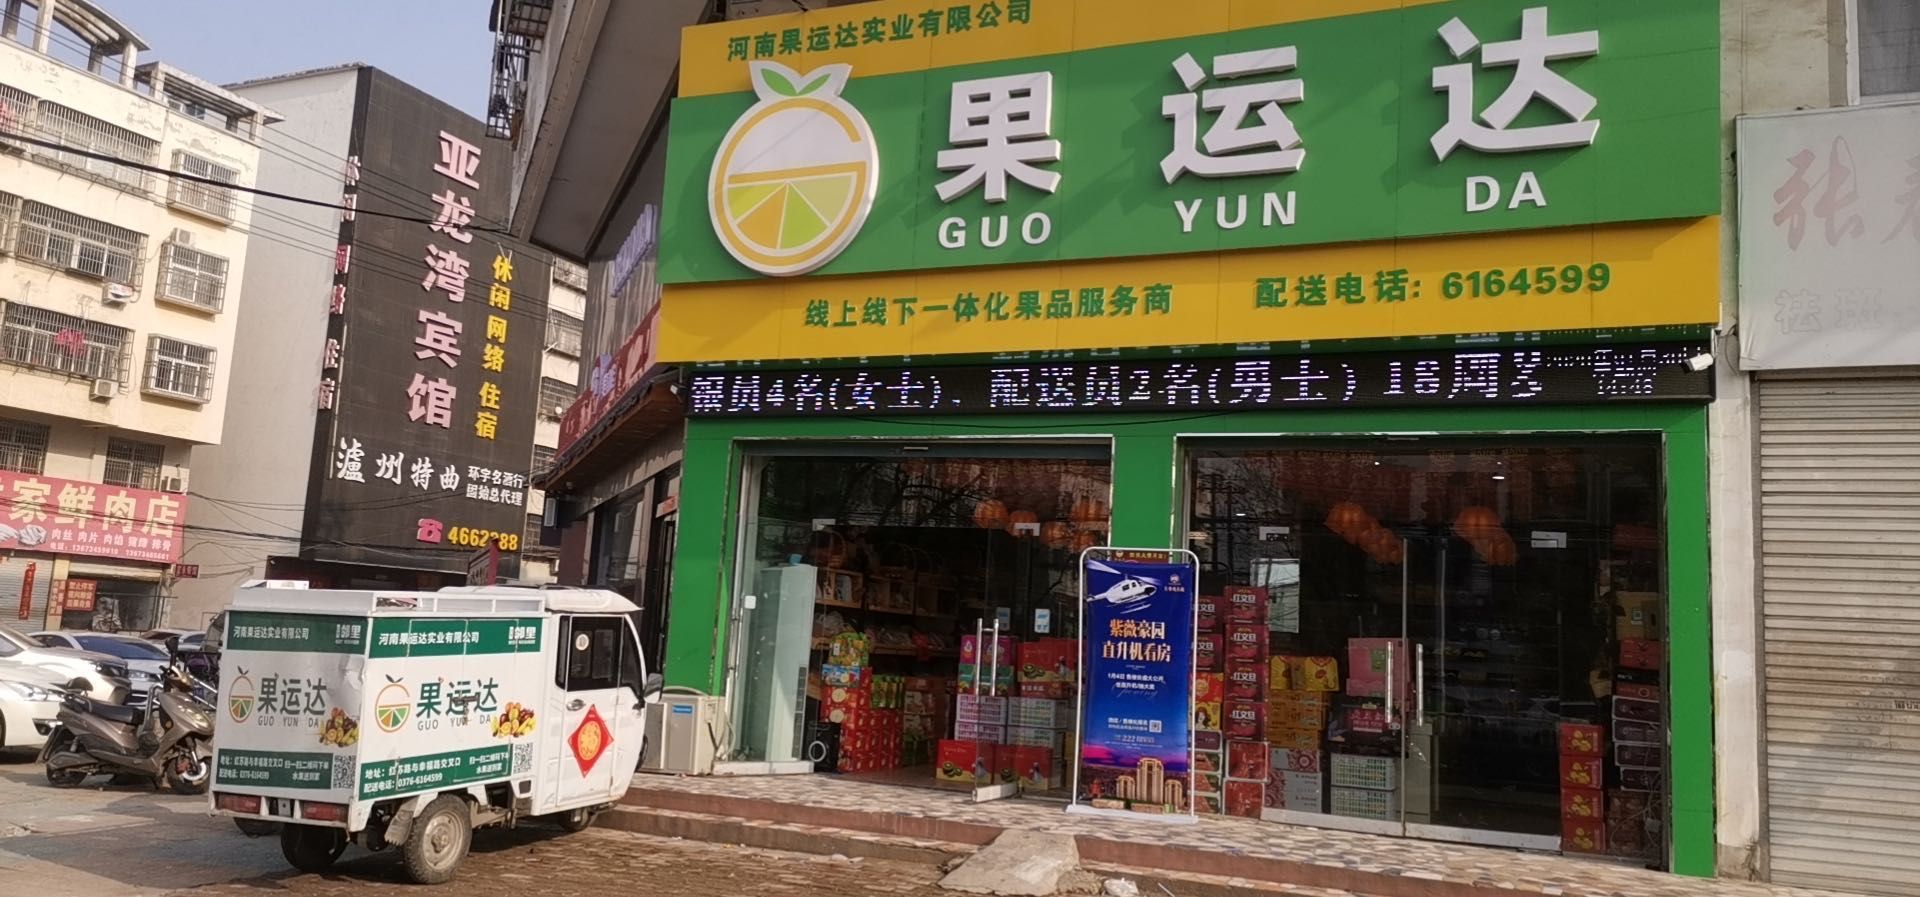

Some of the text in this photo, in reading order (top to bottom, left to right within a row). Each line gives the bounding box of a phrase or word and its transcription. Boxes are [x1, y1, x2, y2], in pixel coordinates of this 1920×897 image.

[727, 0, 1033, 62] 河南果运达实业有限公司
[935, 7, 1600, 204] 果运达
[938, 171, 1547, 249] GUO YUN DA
[406, 130, 483, 430] 亚龙湾宾馆
[804, 283, 1174, 328] 线上线下一体化果品服务商
[1441, 262, 1612, 300] 6164599
[0, 478, 181, 539] 家鲜肉店
[465, 483, 524, 507] 固始总代理
[233, 626, 309, 640] 河南果运达实业有限公司
[378, 631, 480, 646] 河南果运达实业有限公司
[1109, 619, 1166, 640] 紫薇豪园
[1102, 640, 1172, 663] 直升机看房
[257, 677, 328, 716] 果运达
[415, 677, 499, 719] 果运达
[258, 715, 319, 728] GUO YUN DA
[417, 719, 439, 732] GUO
[479, 714, 491, 725] DA
[398, 773, 443, 788] 0376-6164599
